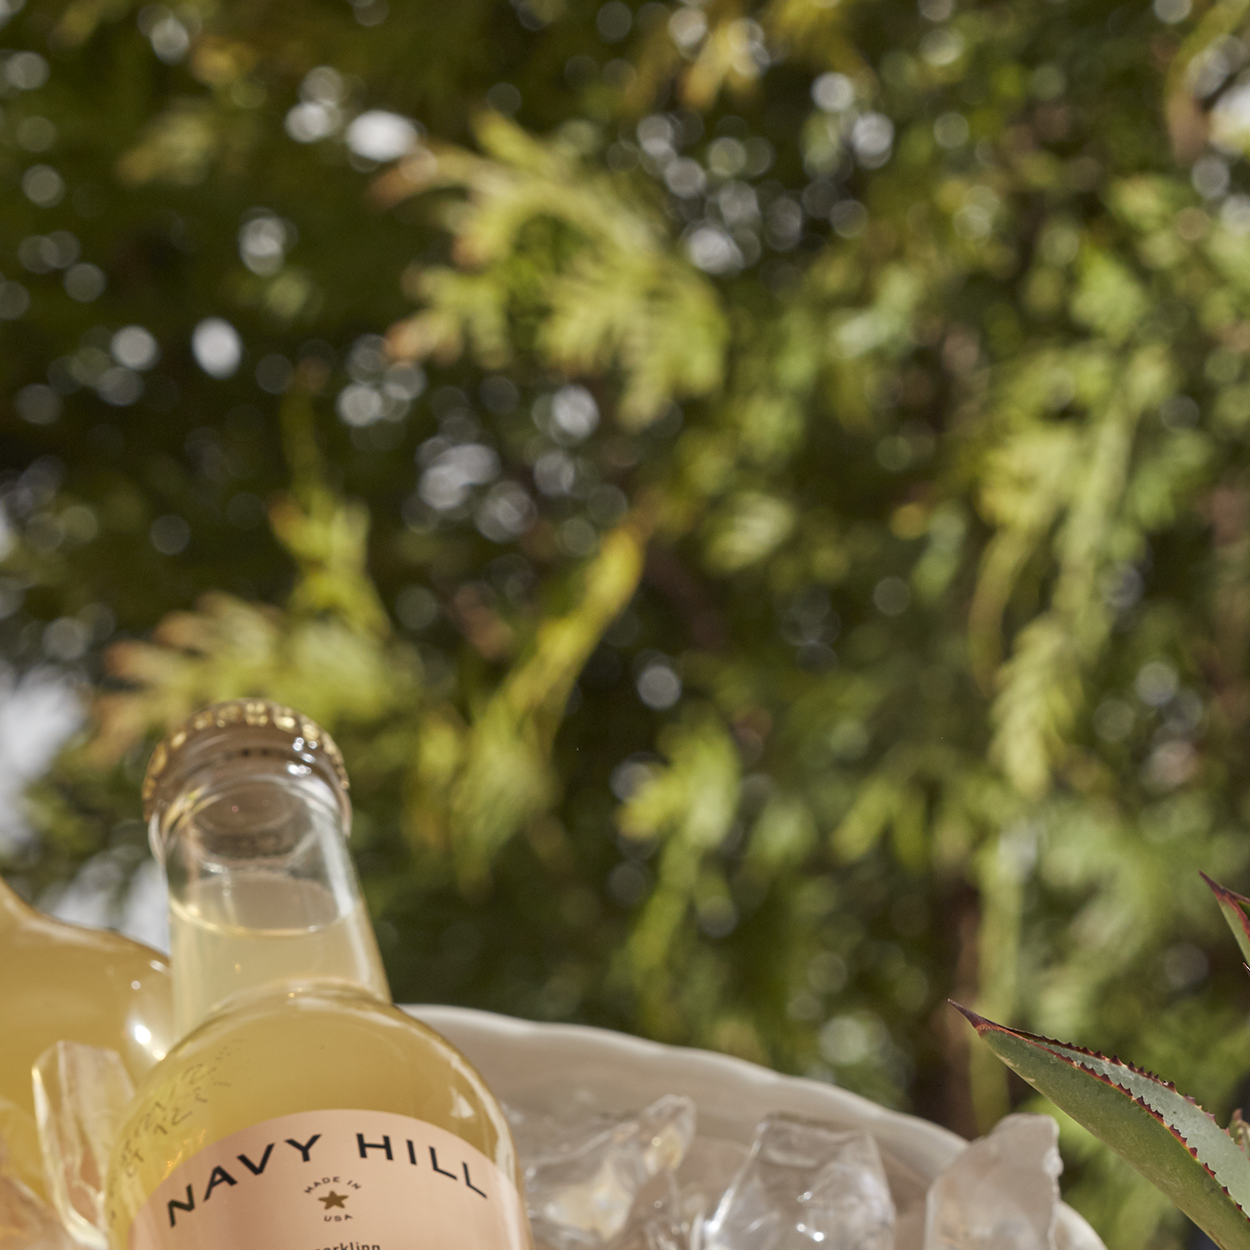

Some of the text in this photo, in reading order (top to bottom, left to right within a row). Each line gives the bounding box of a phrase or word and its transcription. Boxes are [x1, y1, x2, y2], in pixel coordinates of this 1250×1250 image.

[167, 1132, 487, 1228] NAVY HILL
[303, 1176, 362, 1194] MADE IN
[323, 1213, 353, 1223] USA
